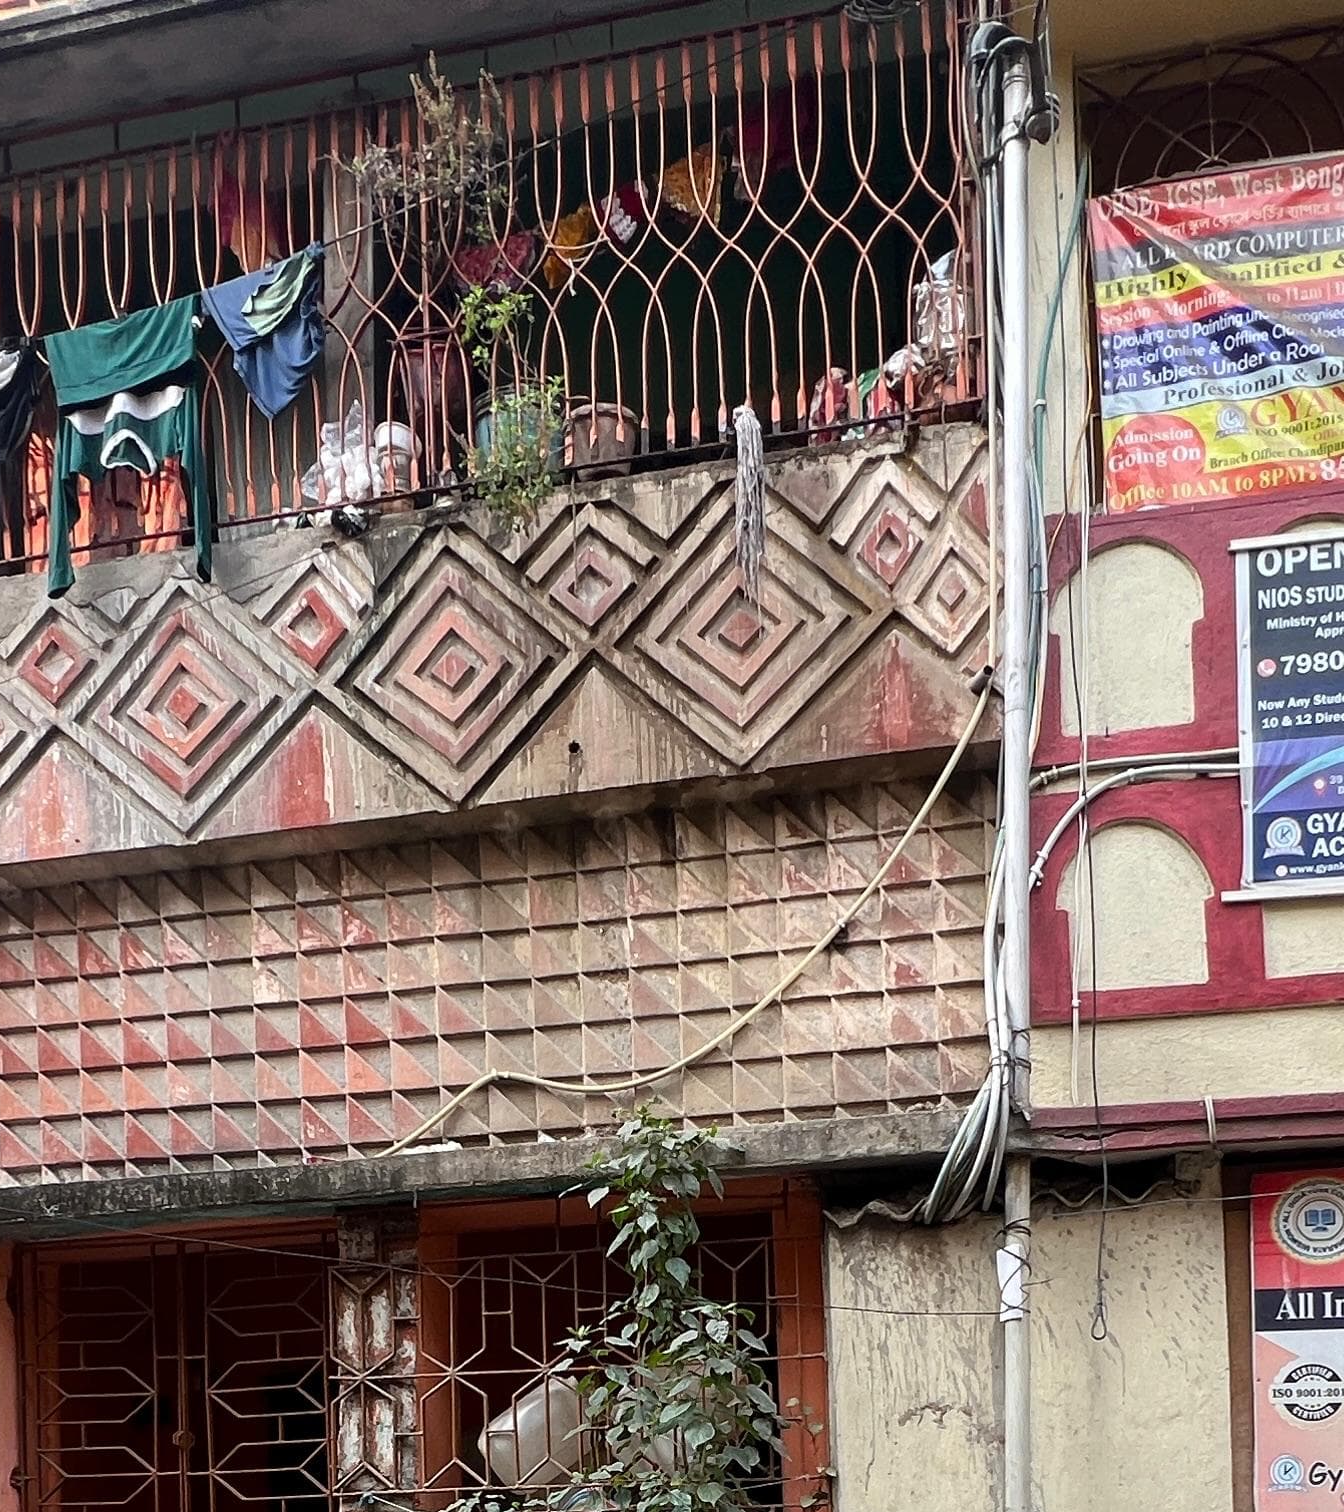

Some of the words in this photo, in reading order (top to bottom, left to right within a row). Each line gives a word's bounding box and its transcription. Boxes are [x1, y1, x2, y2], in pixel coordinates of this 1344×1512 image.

[1163, 371, 1285, 405] Professional
[1108, 446, 1168, 473] Going
[1172, 445, 1201, 462] On
[1258, 586, 1302, 610] NIOS
[1275, 1292, 1314, 1321] All
[1272, 1387, 1294, 1398] ISO
